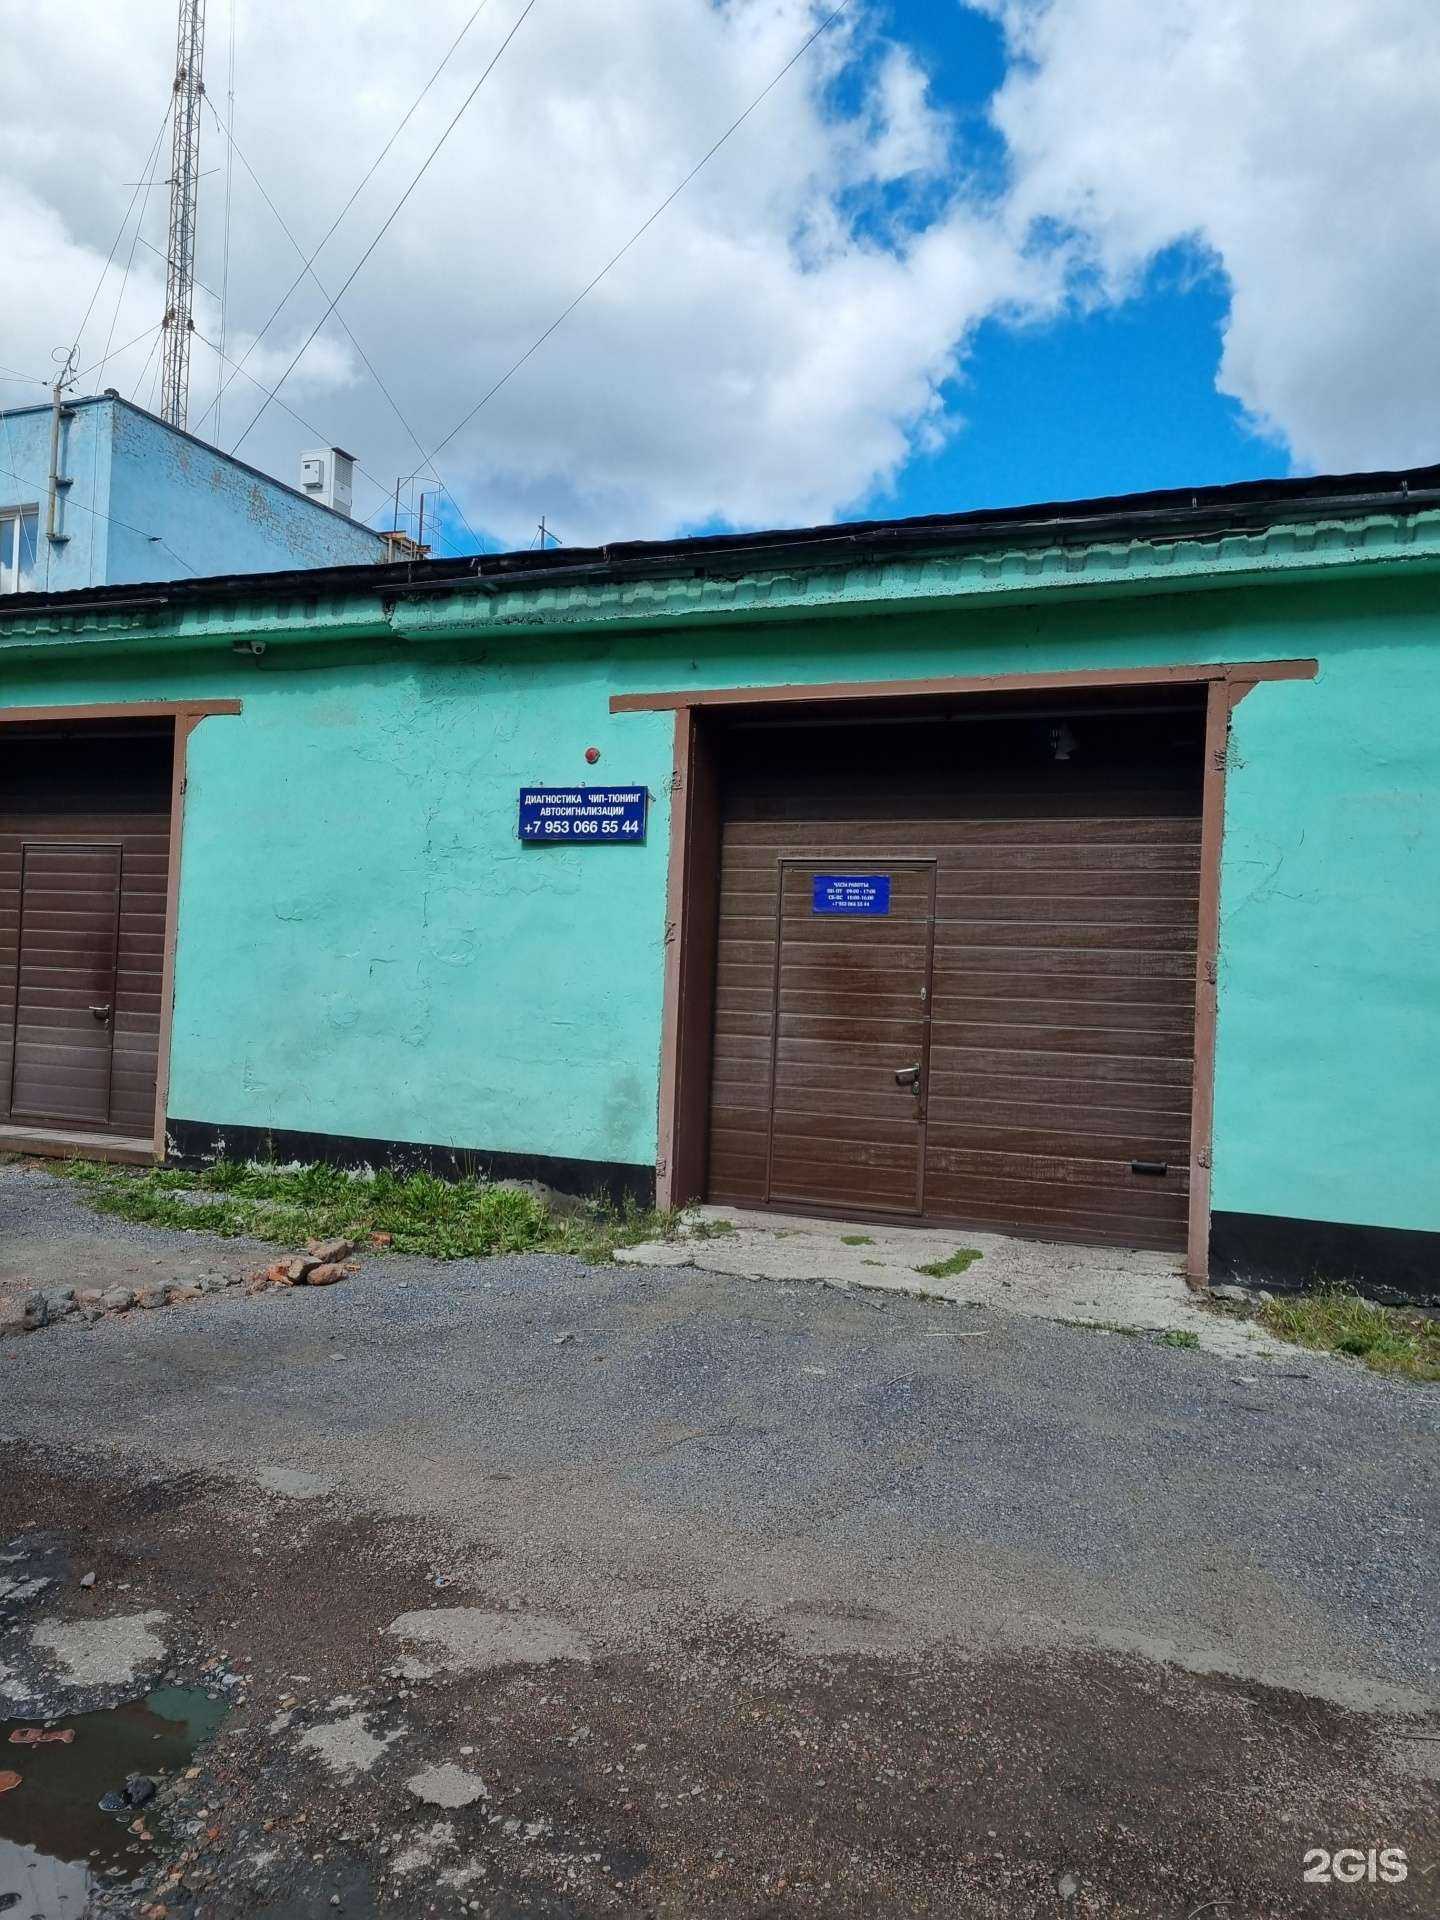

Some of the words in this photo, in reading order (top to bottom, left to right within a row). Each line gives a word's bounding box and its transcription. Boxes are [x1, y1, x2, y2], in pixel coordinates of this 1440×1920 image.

[524, 794, 582, 805] ДИАГНОСТИКА
[588, 793, 641, 803] ЧИП-ТЮНИНГ
[540, 806, 624, 816] АВТОСИГНАЛИЗАЦИИ
[524, 821, 541, 833] +7
[544, 821, 570, 833] 953
[573, 821, 598, 833] 066
[601, 820, 618, 833] 55
[621, 820, 639, 833] 44
